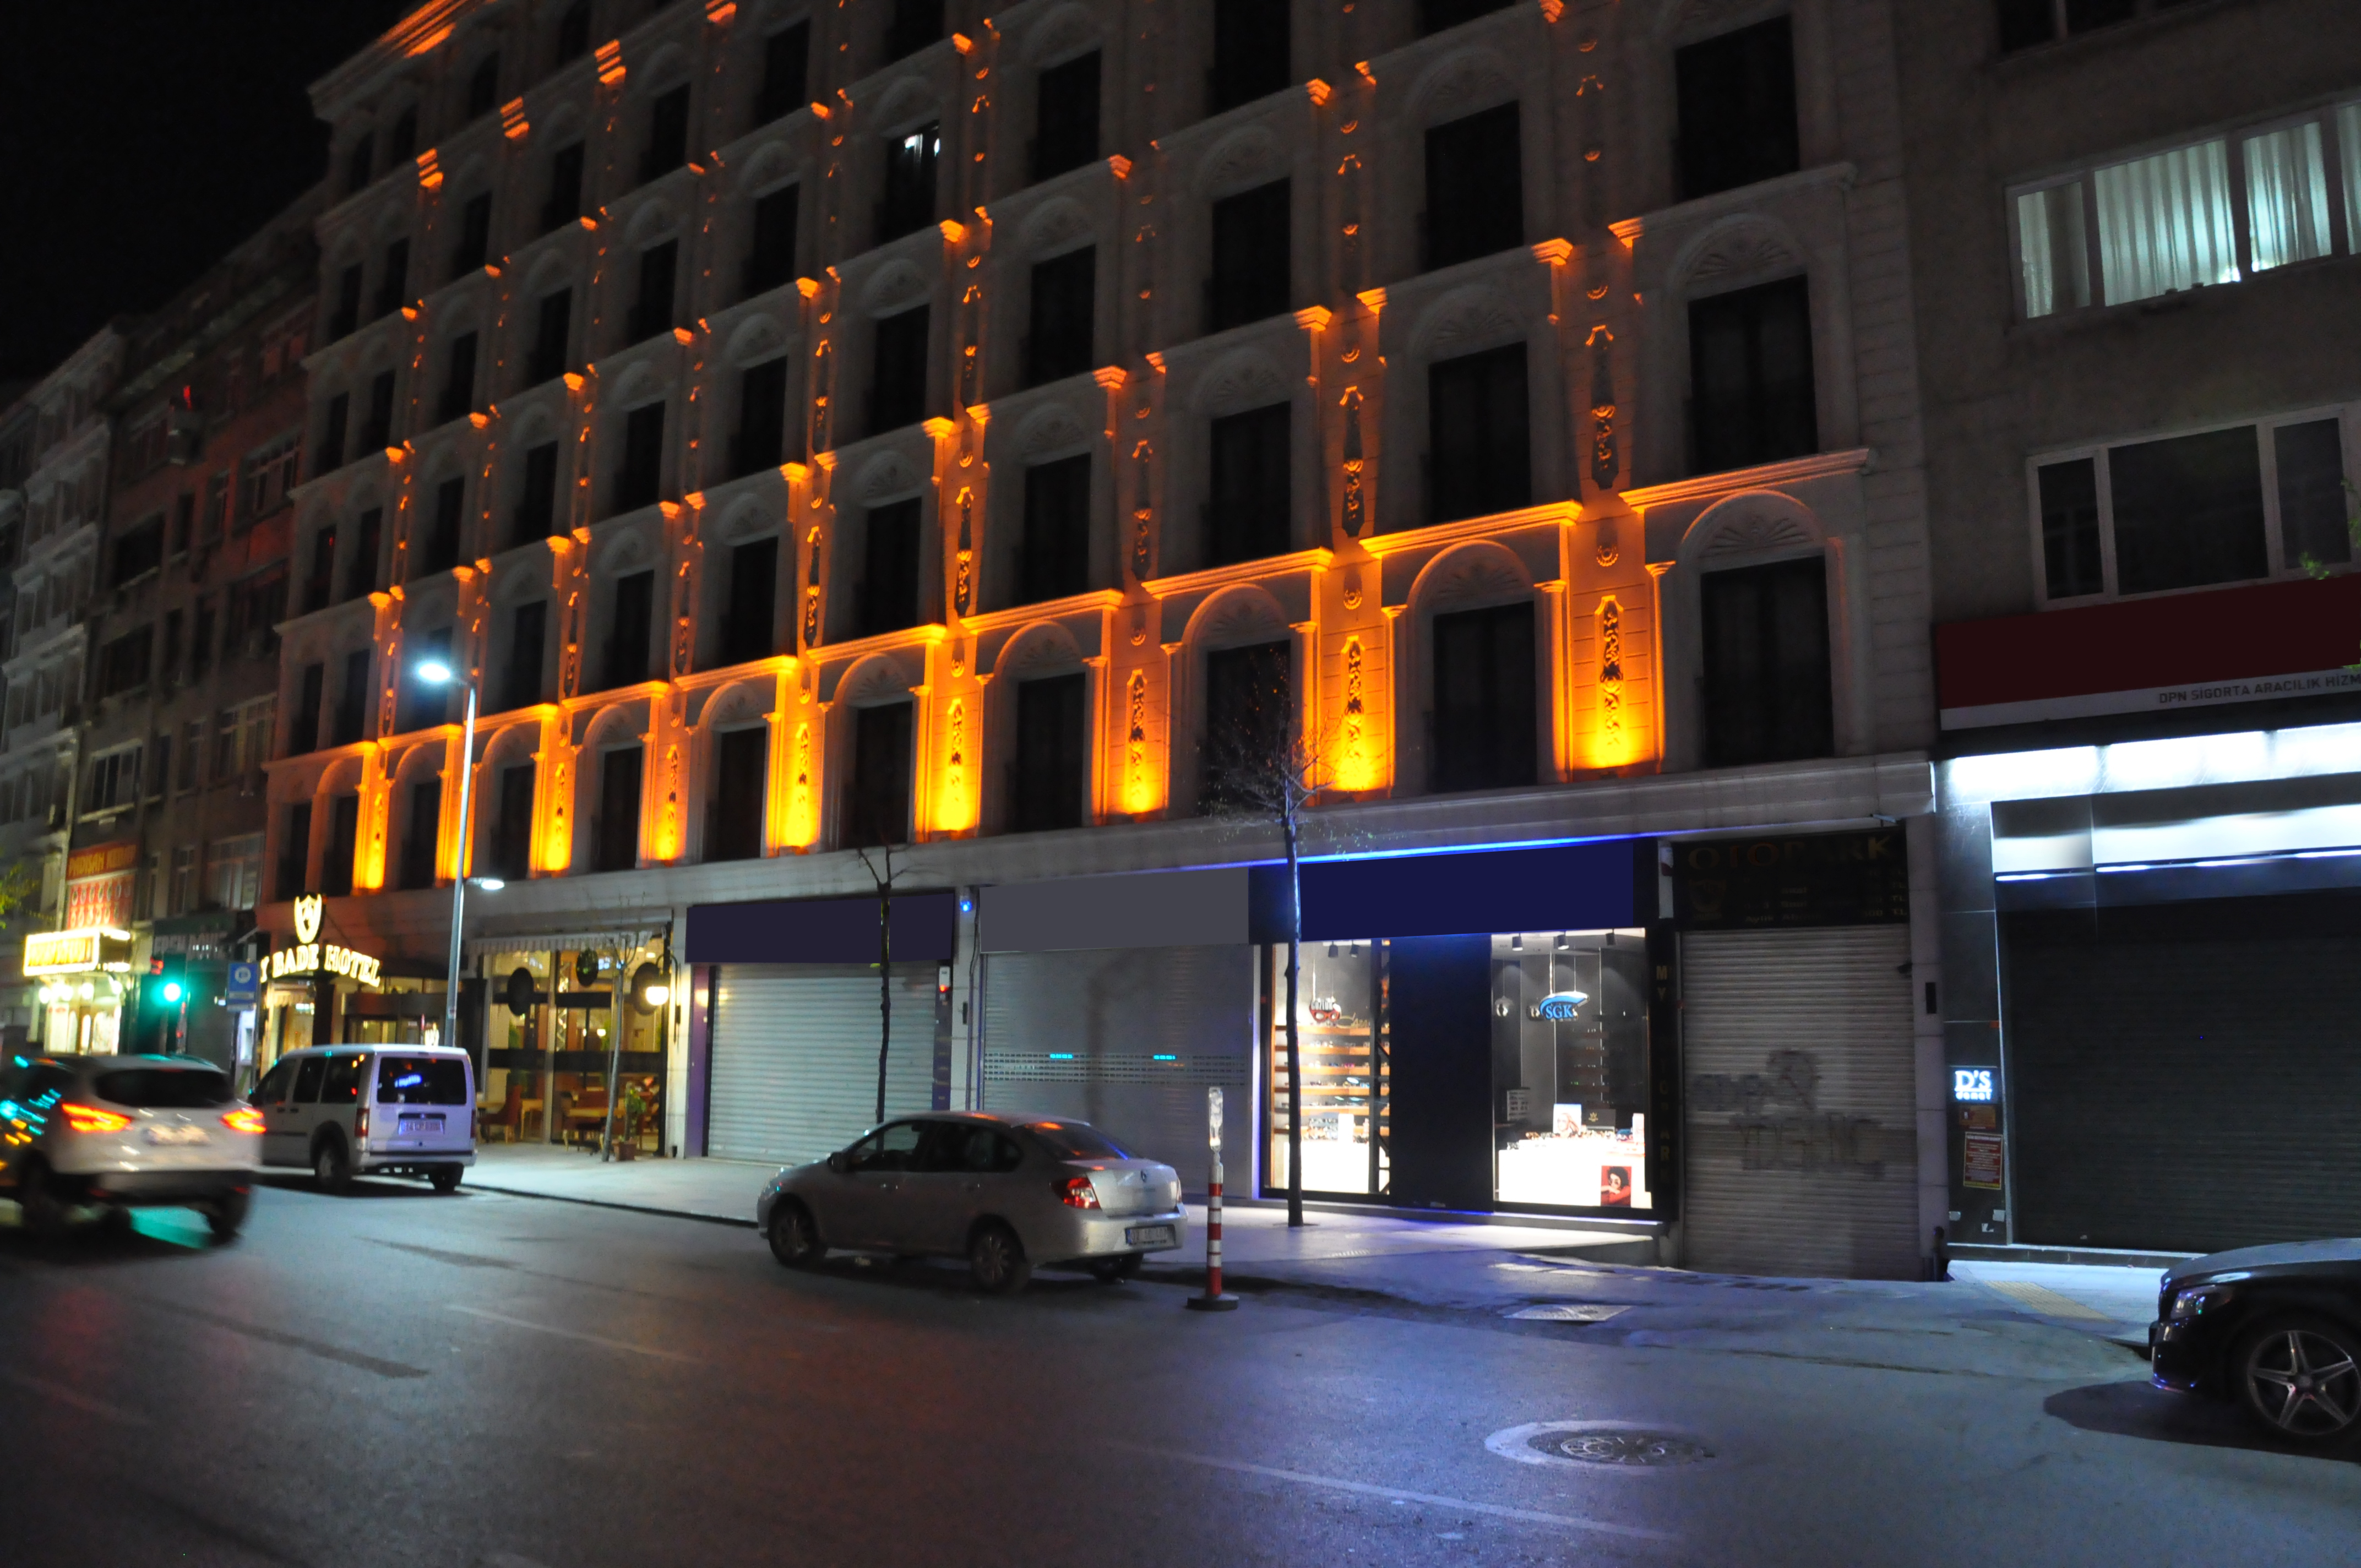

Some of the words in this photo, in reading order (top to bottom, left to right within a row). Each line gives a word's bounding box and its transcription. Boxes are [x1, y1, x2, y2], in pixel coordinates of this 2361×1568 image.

[2159, 691, 2187, 704] DPN
[2191, 685, 2250, 700] SİGORTA
[2254, 677, 2320, 694] ARACILIK
[272, 944, 319, 978] BADE
[324, 944, 380, 988] HOTEL
[1545, 1004, 1574, 1020] SGK
[1955, 1070, 1992, 1088] D'S
